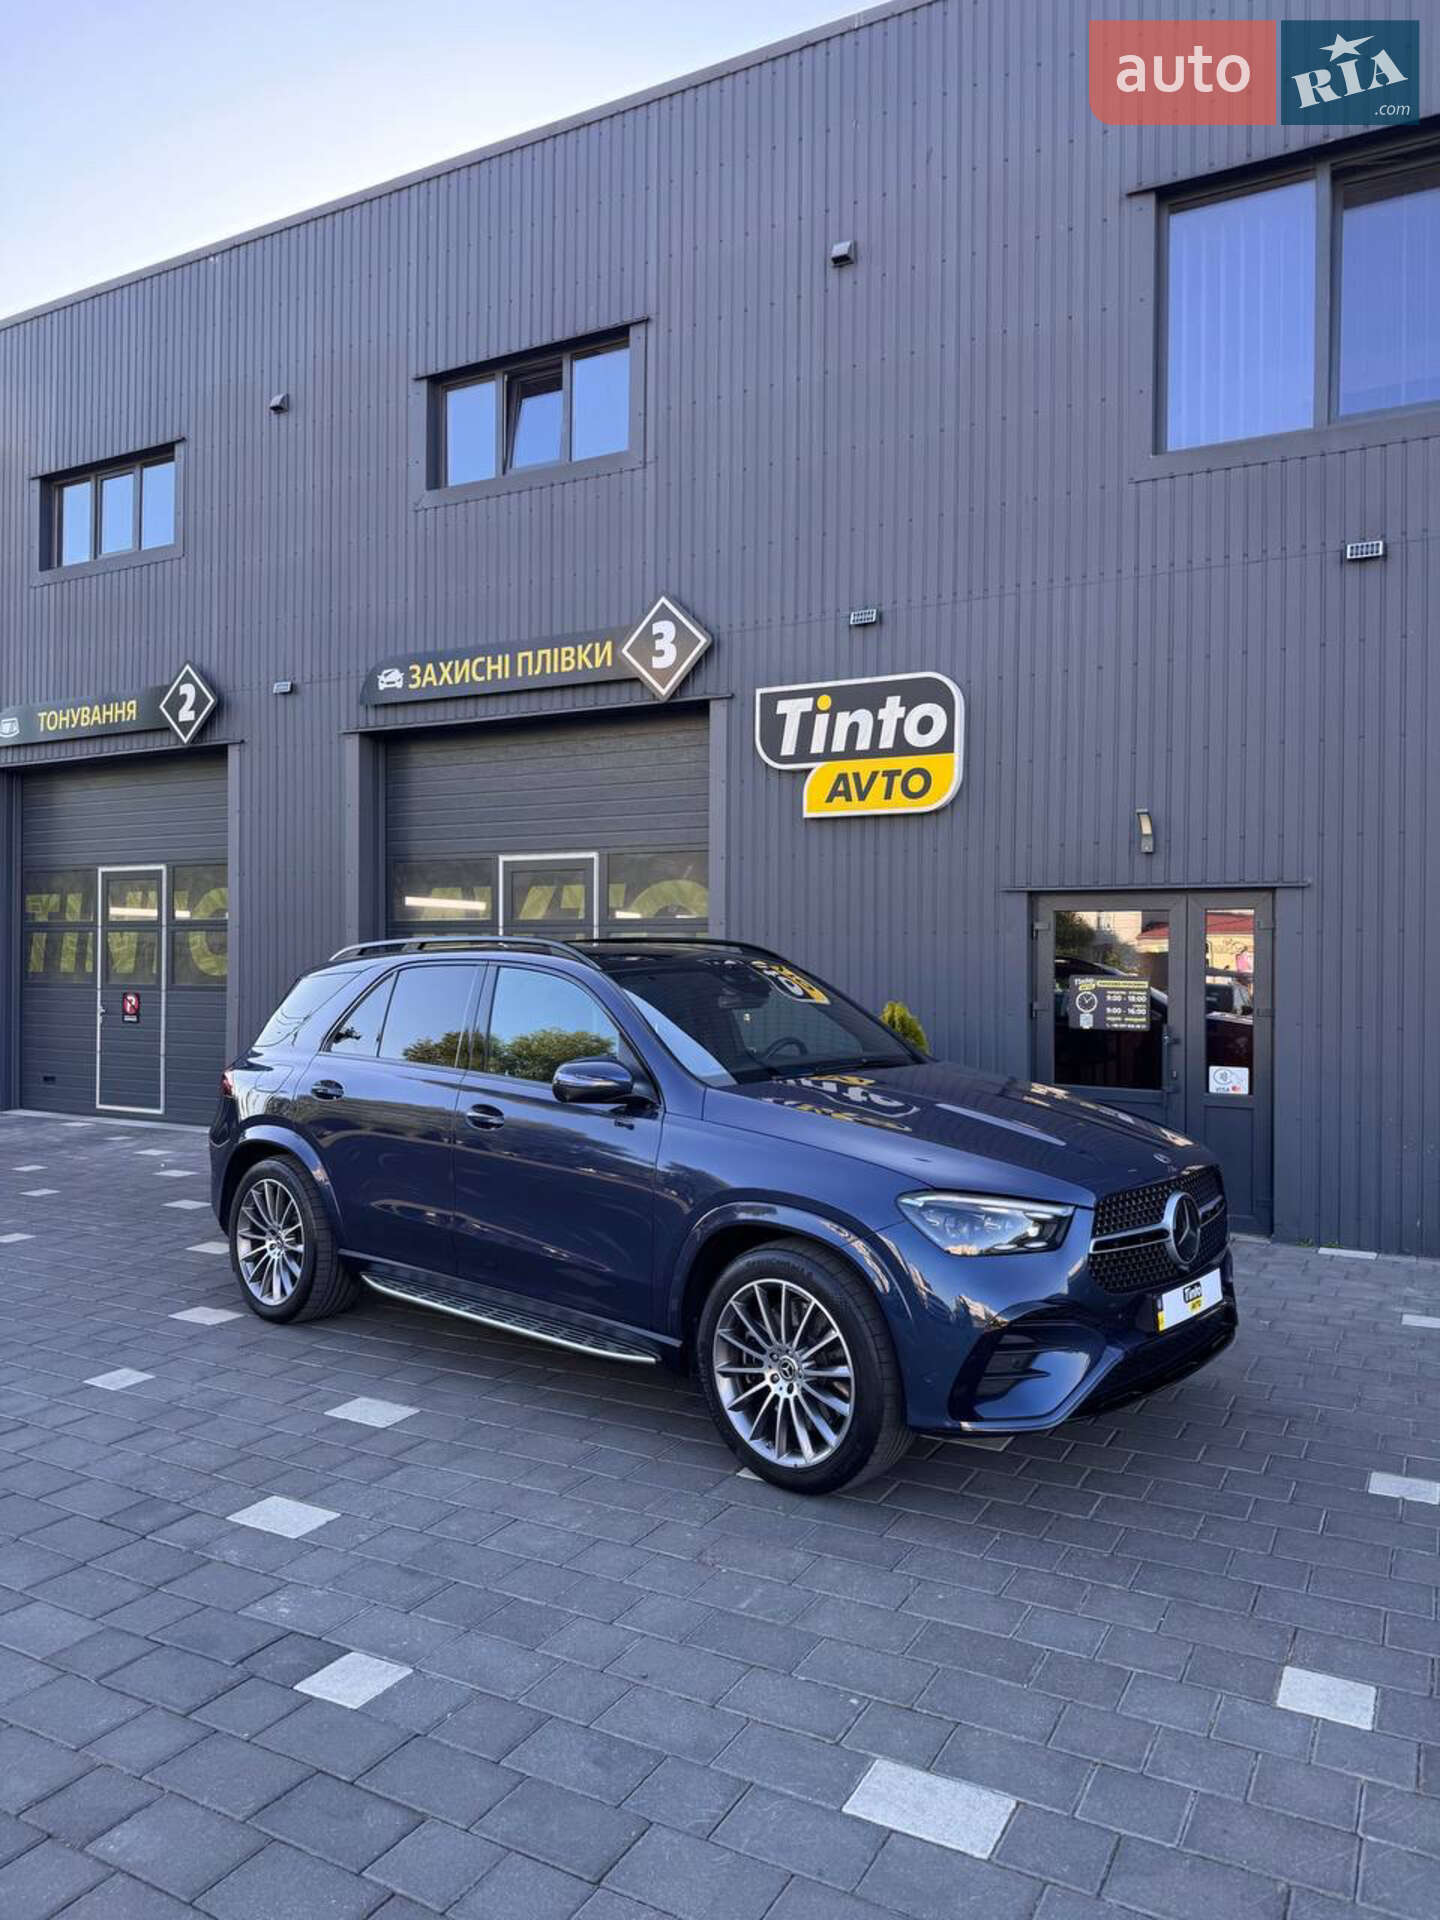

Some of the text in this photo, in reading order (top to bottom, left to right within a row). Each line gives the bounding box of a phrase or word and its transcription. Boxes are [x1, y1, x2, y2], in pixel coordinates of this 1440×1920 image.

[408, 640, 612, 690] ЗАХИСНІ ПЛІВКИ
[651, 620, 677, 669] 3
[38, 700, 137, 732] ТОНУВАННЯ
[178, 683, 196, 722] 2
[776, 694, 947, 756] Tinto
[825, 767, 932, 803] AVTO
